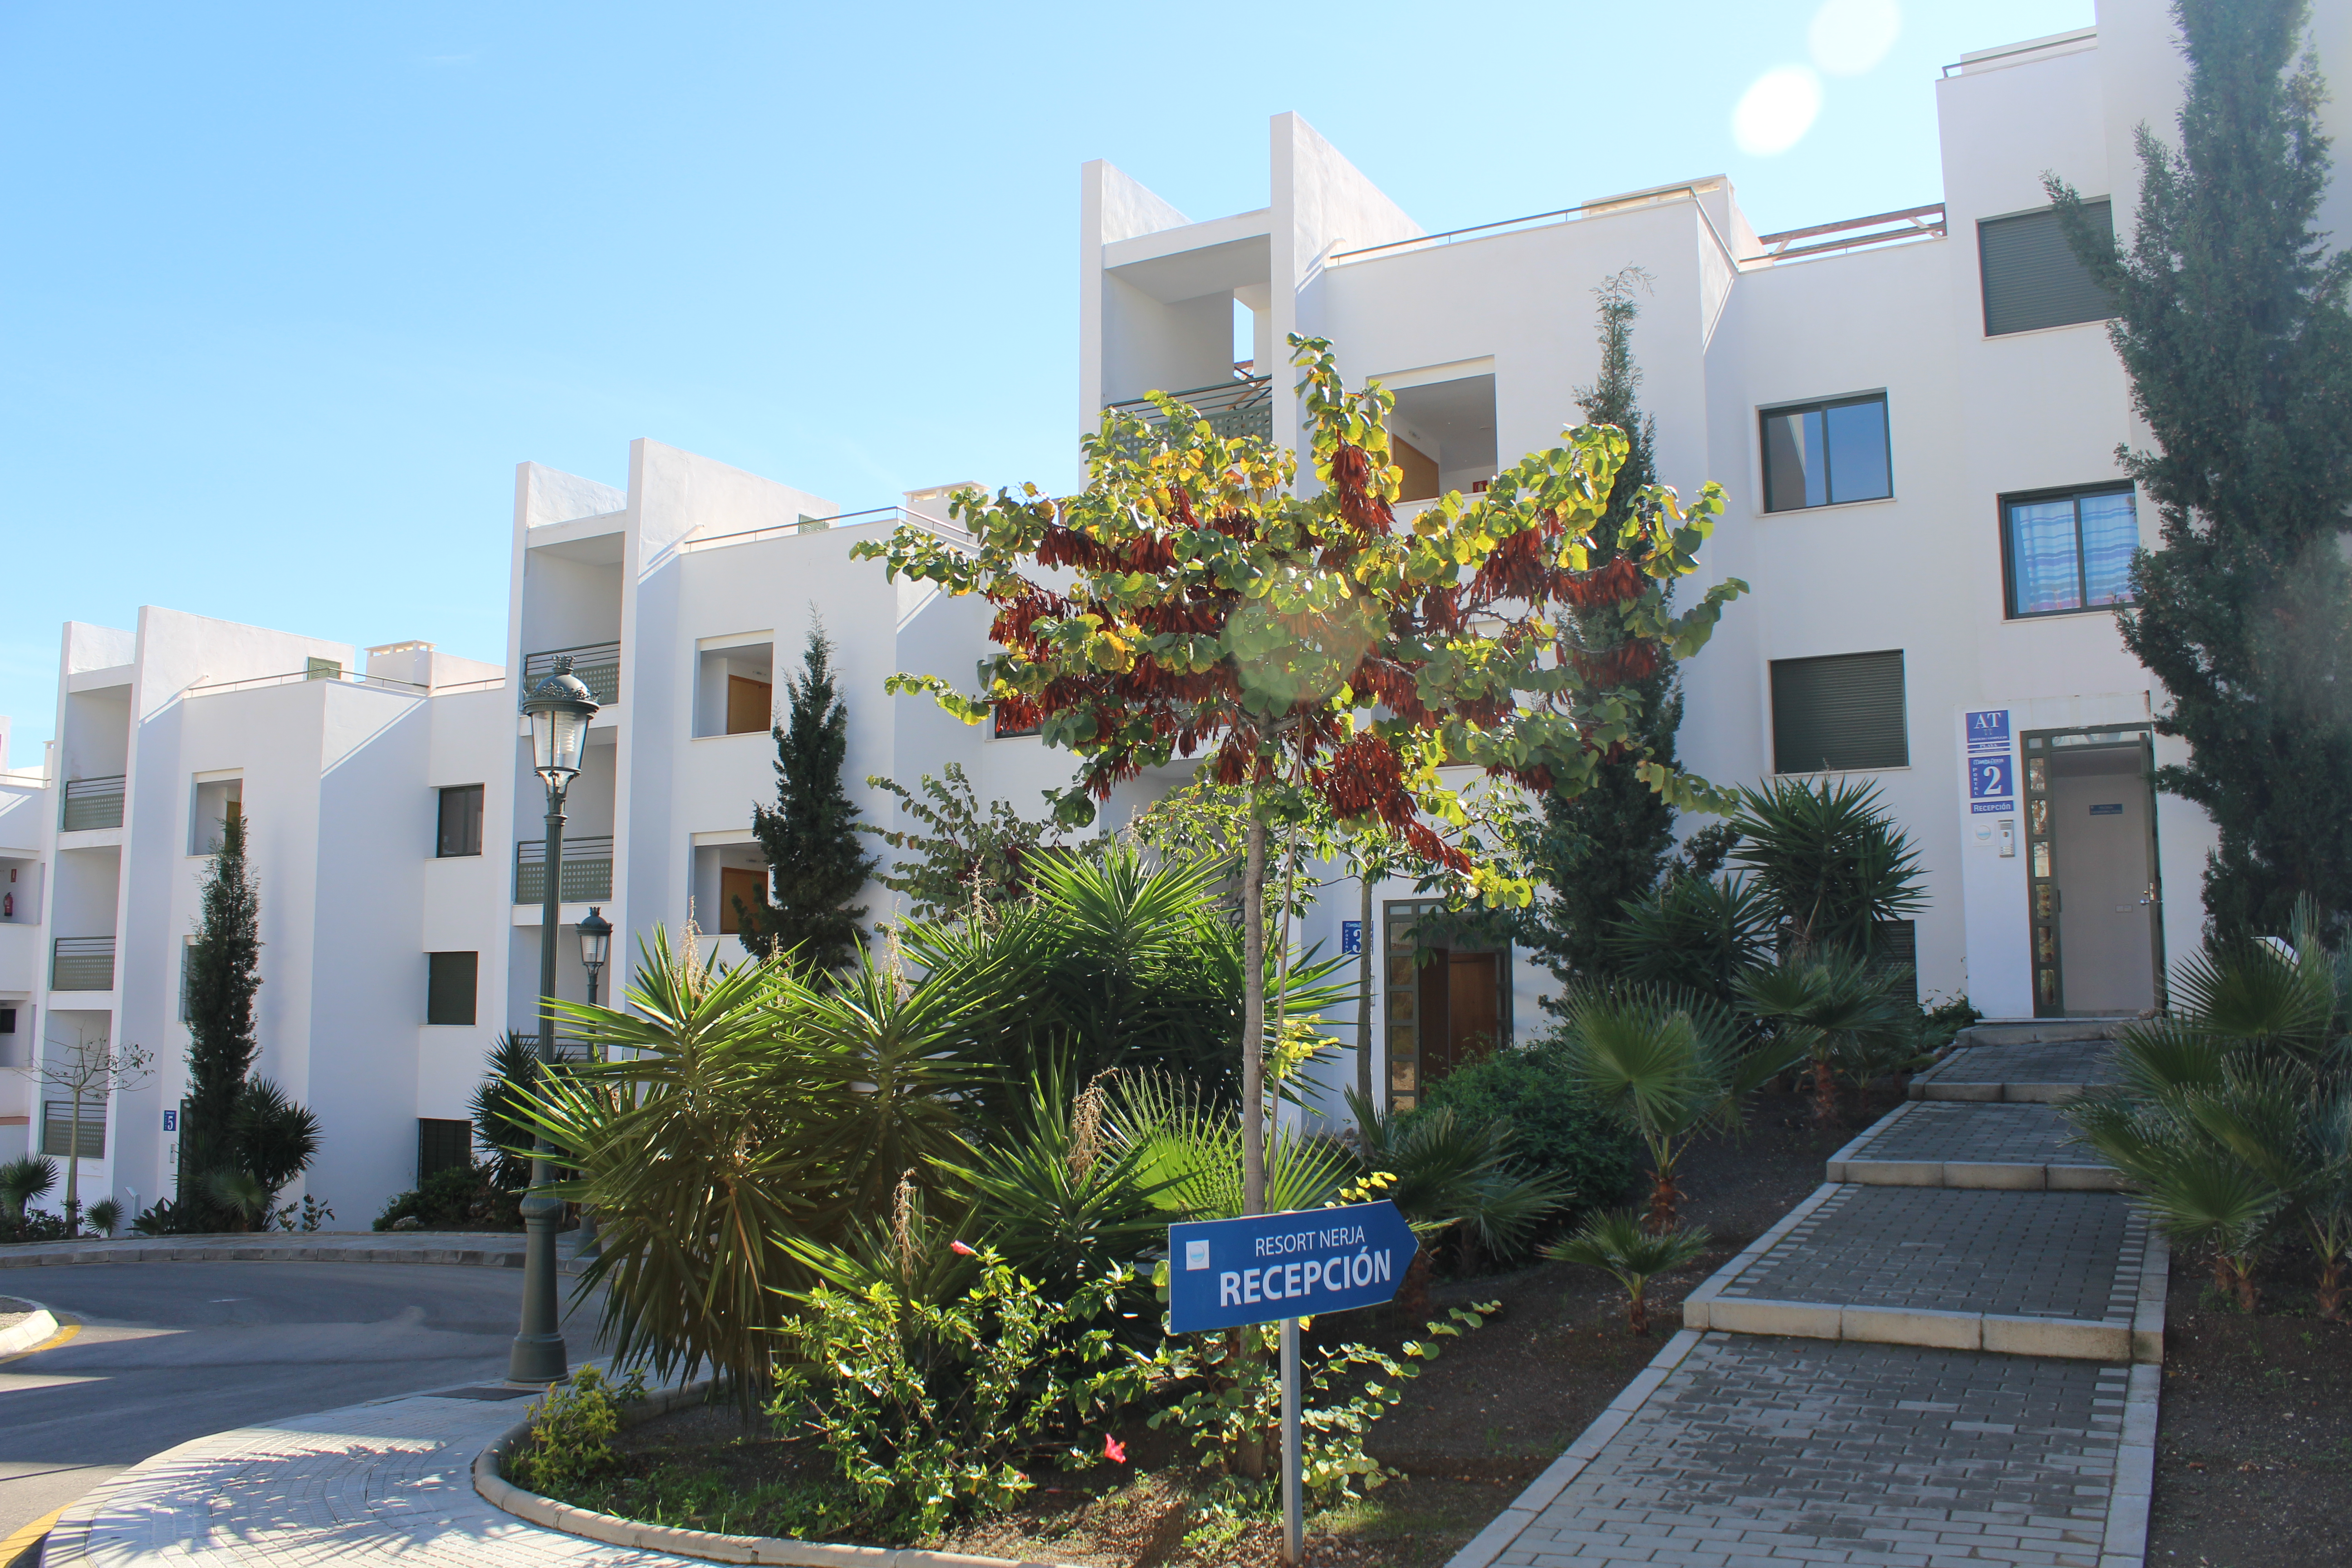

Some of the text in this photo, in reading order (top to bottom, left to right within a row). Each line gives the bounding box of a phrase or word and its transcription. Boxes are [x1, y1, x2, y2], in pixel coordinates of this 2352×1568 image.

[1974, 712, 2001, 729] AT
[1983, 766, 2002, 795] 2
[1352, 929, 1361, 953] 3
[167, 1115, 173, 1130] 5
[1255, 1225, 1365, 1257] RESORT NERJA
[1220, 1246, 1391, 1307] RECEPCIÓN
